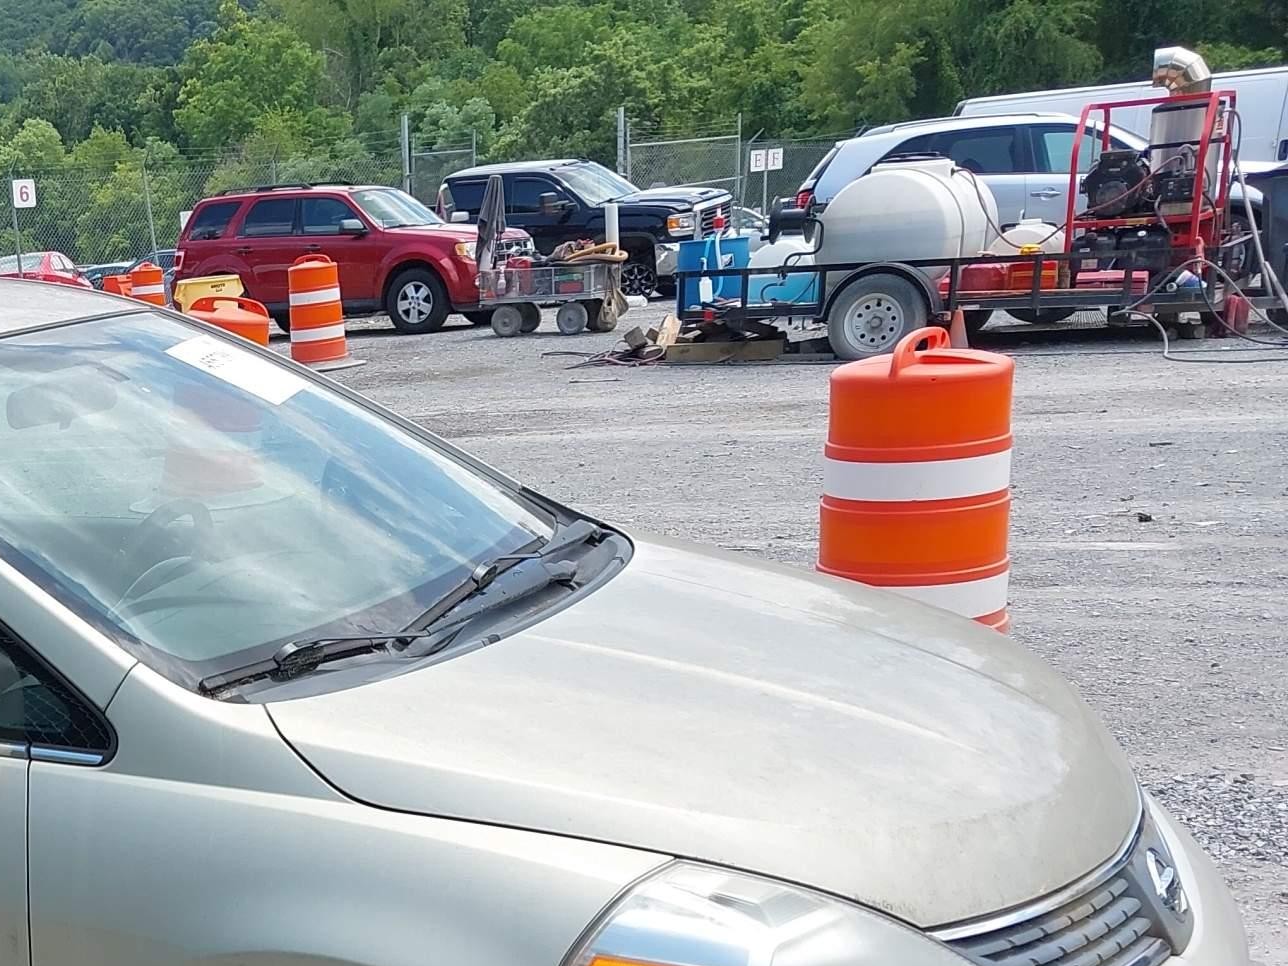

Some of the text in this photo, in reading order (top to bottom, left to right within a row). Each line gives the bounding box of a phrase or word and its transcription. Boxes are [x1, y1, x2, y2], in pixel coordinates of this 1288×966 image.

[754, 153, 762, 168] E
[771, 152, 780, 167] F
[19, 185, 30, 202] 6
